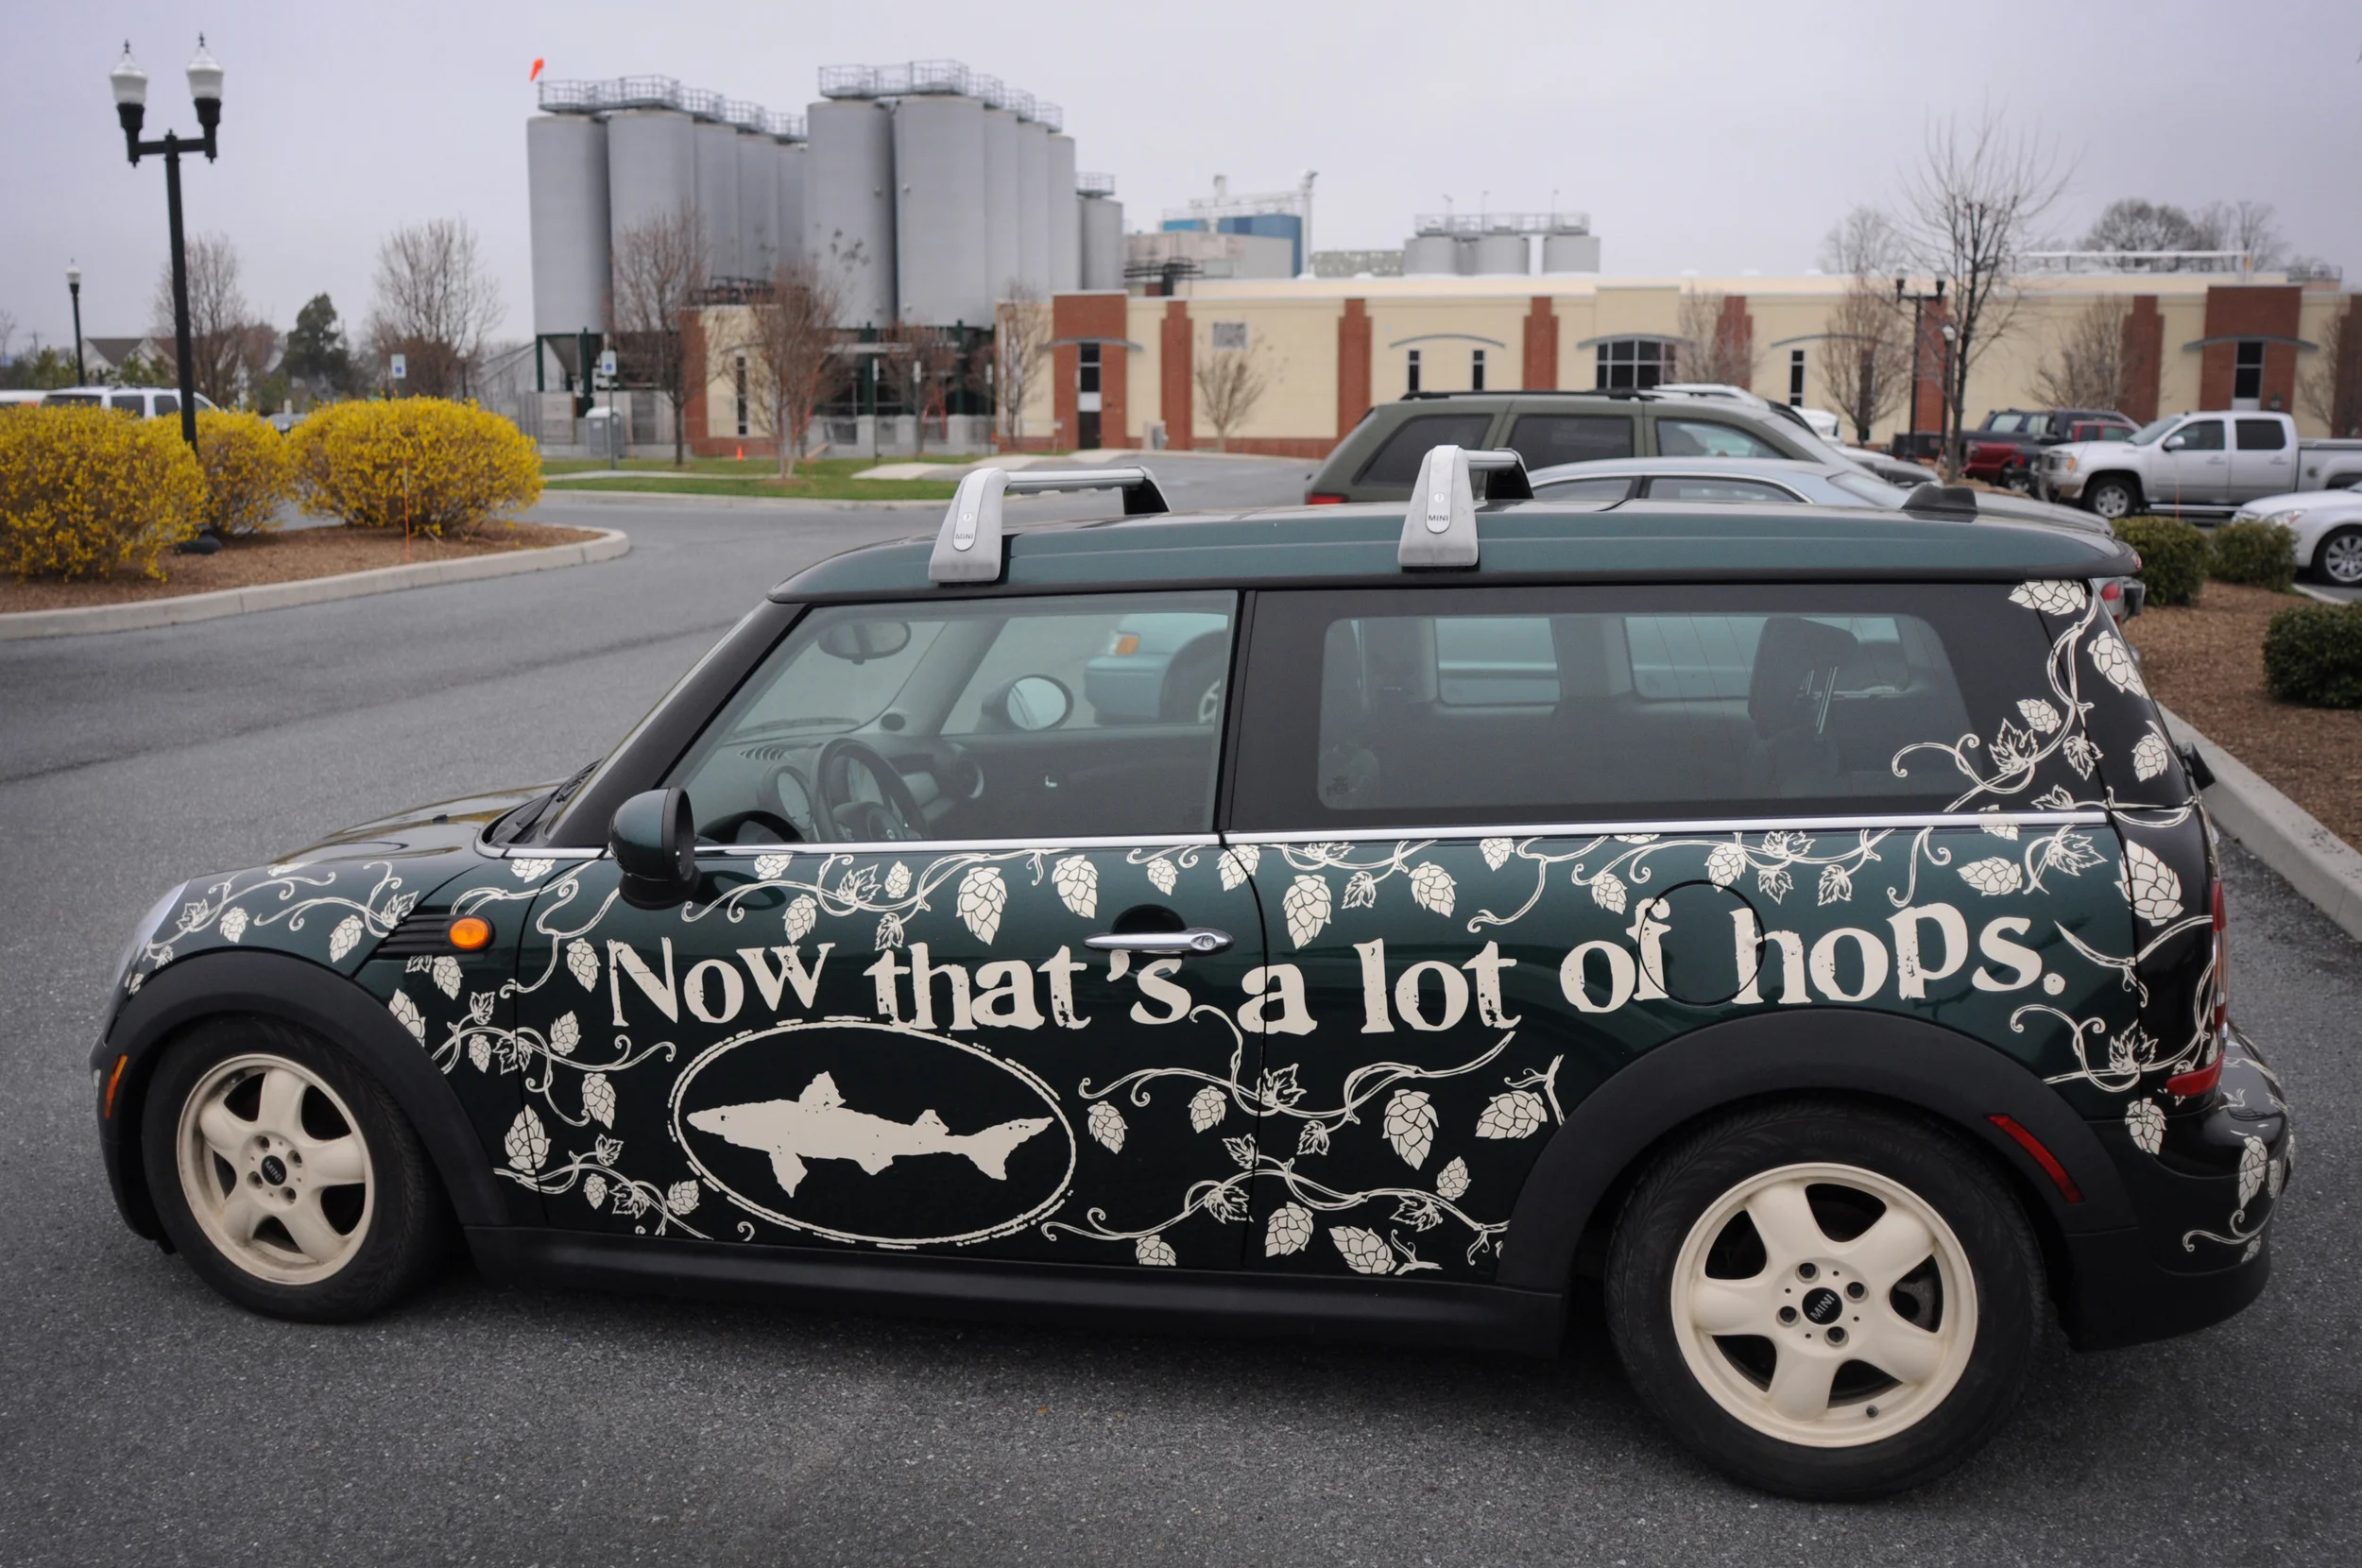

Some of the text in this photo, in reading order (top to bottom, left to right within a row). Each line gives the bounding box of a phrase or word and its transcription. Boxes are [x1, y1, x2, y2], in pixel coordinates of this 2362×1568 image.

[606, 897, 2066, 1036] Now that's a lot of hops.
[265, 1160, 283, 1182] MINI
[1809, 1293, 1836, 1321] MINI
